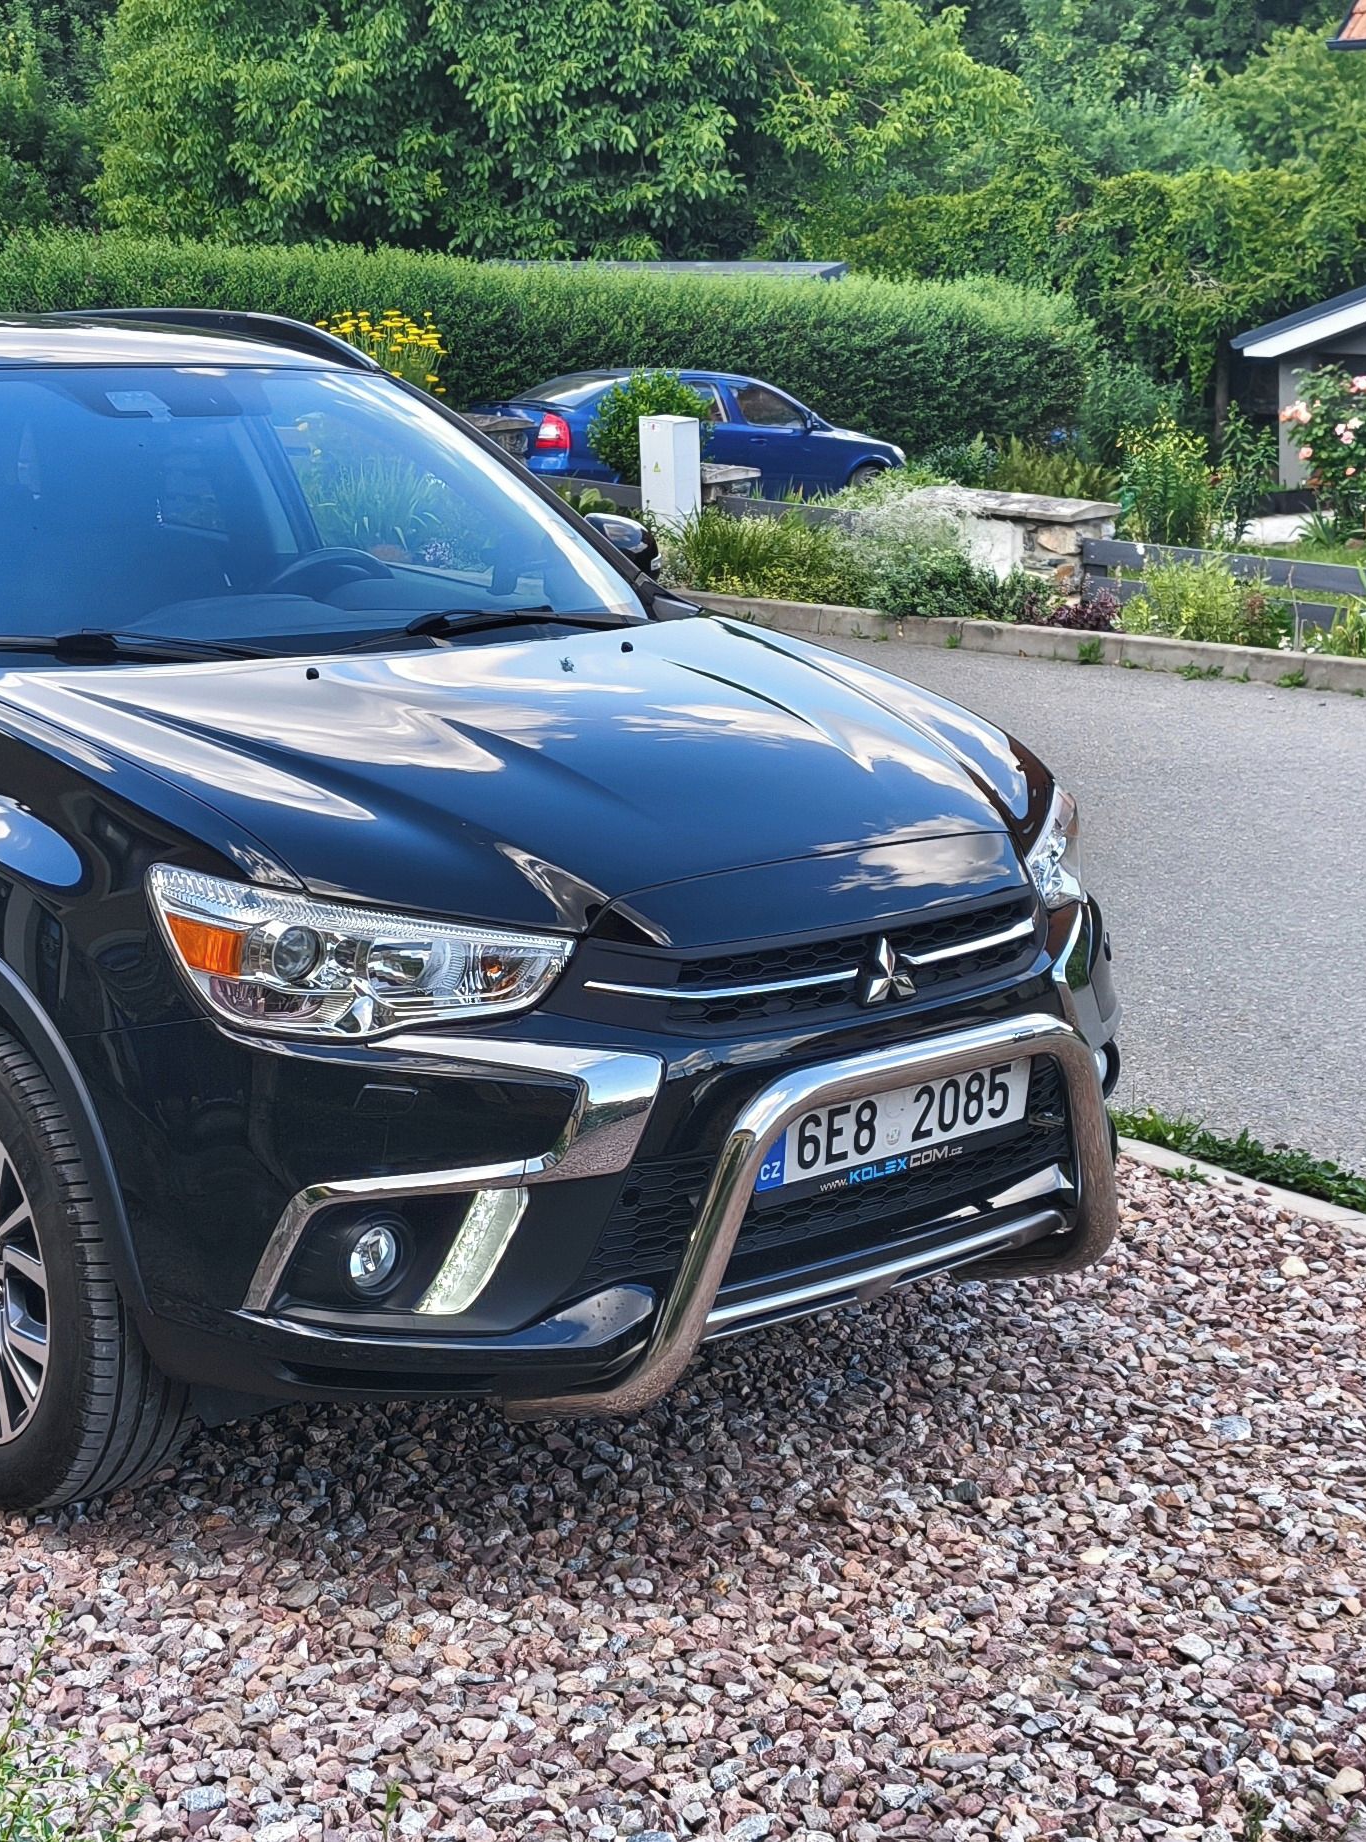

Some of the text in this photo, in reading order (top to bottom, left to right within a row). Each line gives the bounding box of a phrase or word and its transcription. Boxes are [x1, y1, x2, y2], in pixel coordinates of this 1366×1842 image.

[797, 1063, 1012, 1170] 6E8 2085
[759, 1161, 781, 1181] CZ
